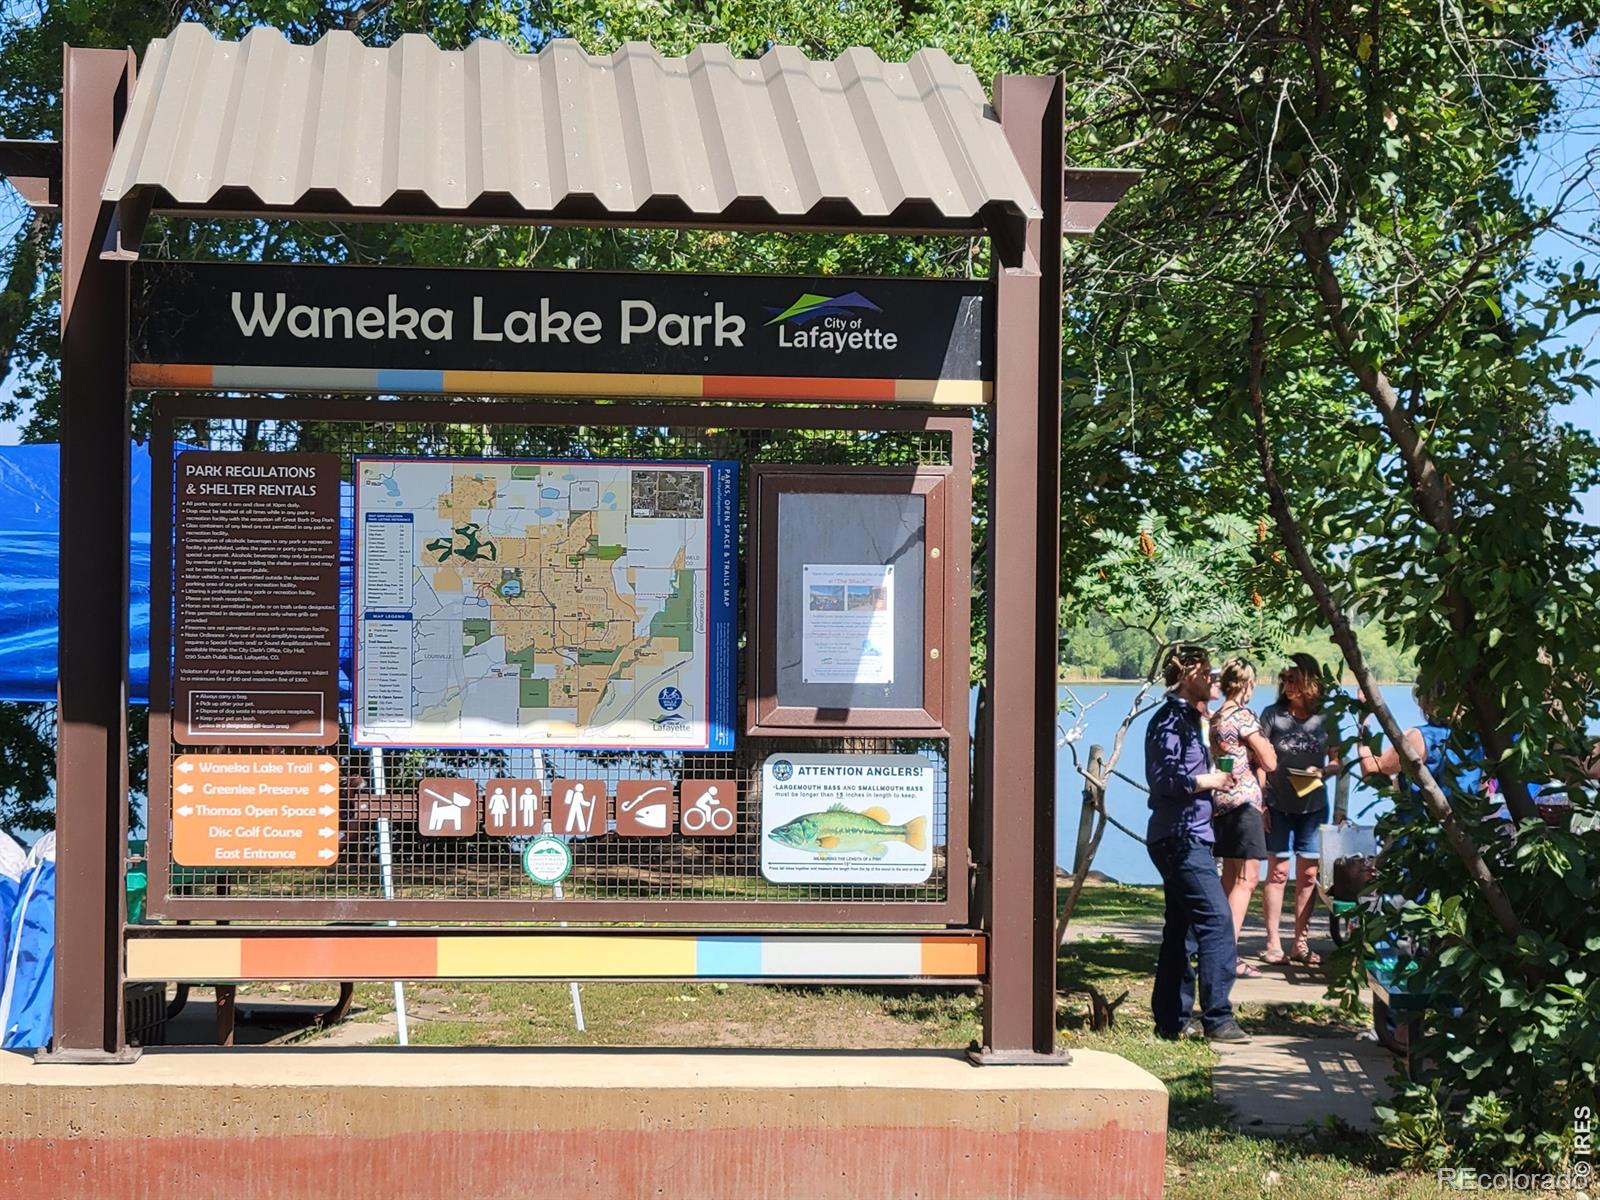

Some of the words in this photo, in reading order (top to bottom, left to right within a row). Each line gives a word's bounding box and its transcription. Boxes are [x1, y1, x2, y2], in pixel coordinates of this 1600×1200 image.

[231, 292, 454, 340] Waneka
[473, 296, 602, 344] Lake
[620, 300, 746, 347] Park
[825, 317, 846, 330] City
[849, 318, 862, 329] of
[779, 324, 898, 354] Lafayette
[186, 465, 222, 477] PARK
[226, 466, 316, 478] REGULATIONS
[186, 483, 196, 494] &
[200, 484, 255, 495] SHELTER
[259, 485, 316, 496] RENTALS
[653, 724, 690, 732] Lafayette
[199, 762, 249, 773] Waneka
[253, 762, 282, 773] Lake
[287, 762, 312, 773] Trail
[798, 767, 863, 776] ATTENTION
[867, 767, 923, 776] ANGLERS!
[203, 784, 256, 794] Greenlee
[259, 784, 309, 795] Preserve
[196, 805, 241, 816] Thomas
[245, 805, 277, 817] Open
[281, 806, 316, 818] Space
[209, 827, 232, 837] Disc
[235, 827, 260, 837] Golf
[263, 827, 302, 837] Course
[215, 848, 240, 858] East
[244, 848, 296, 859] Entrance
